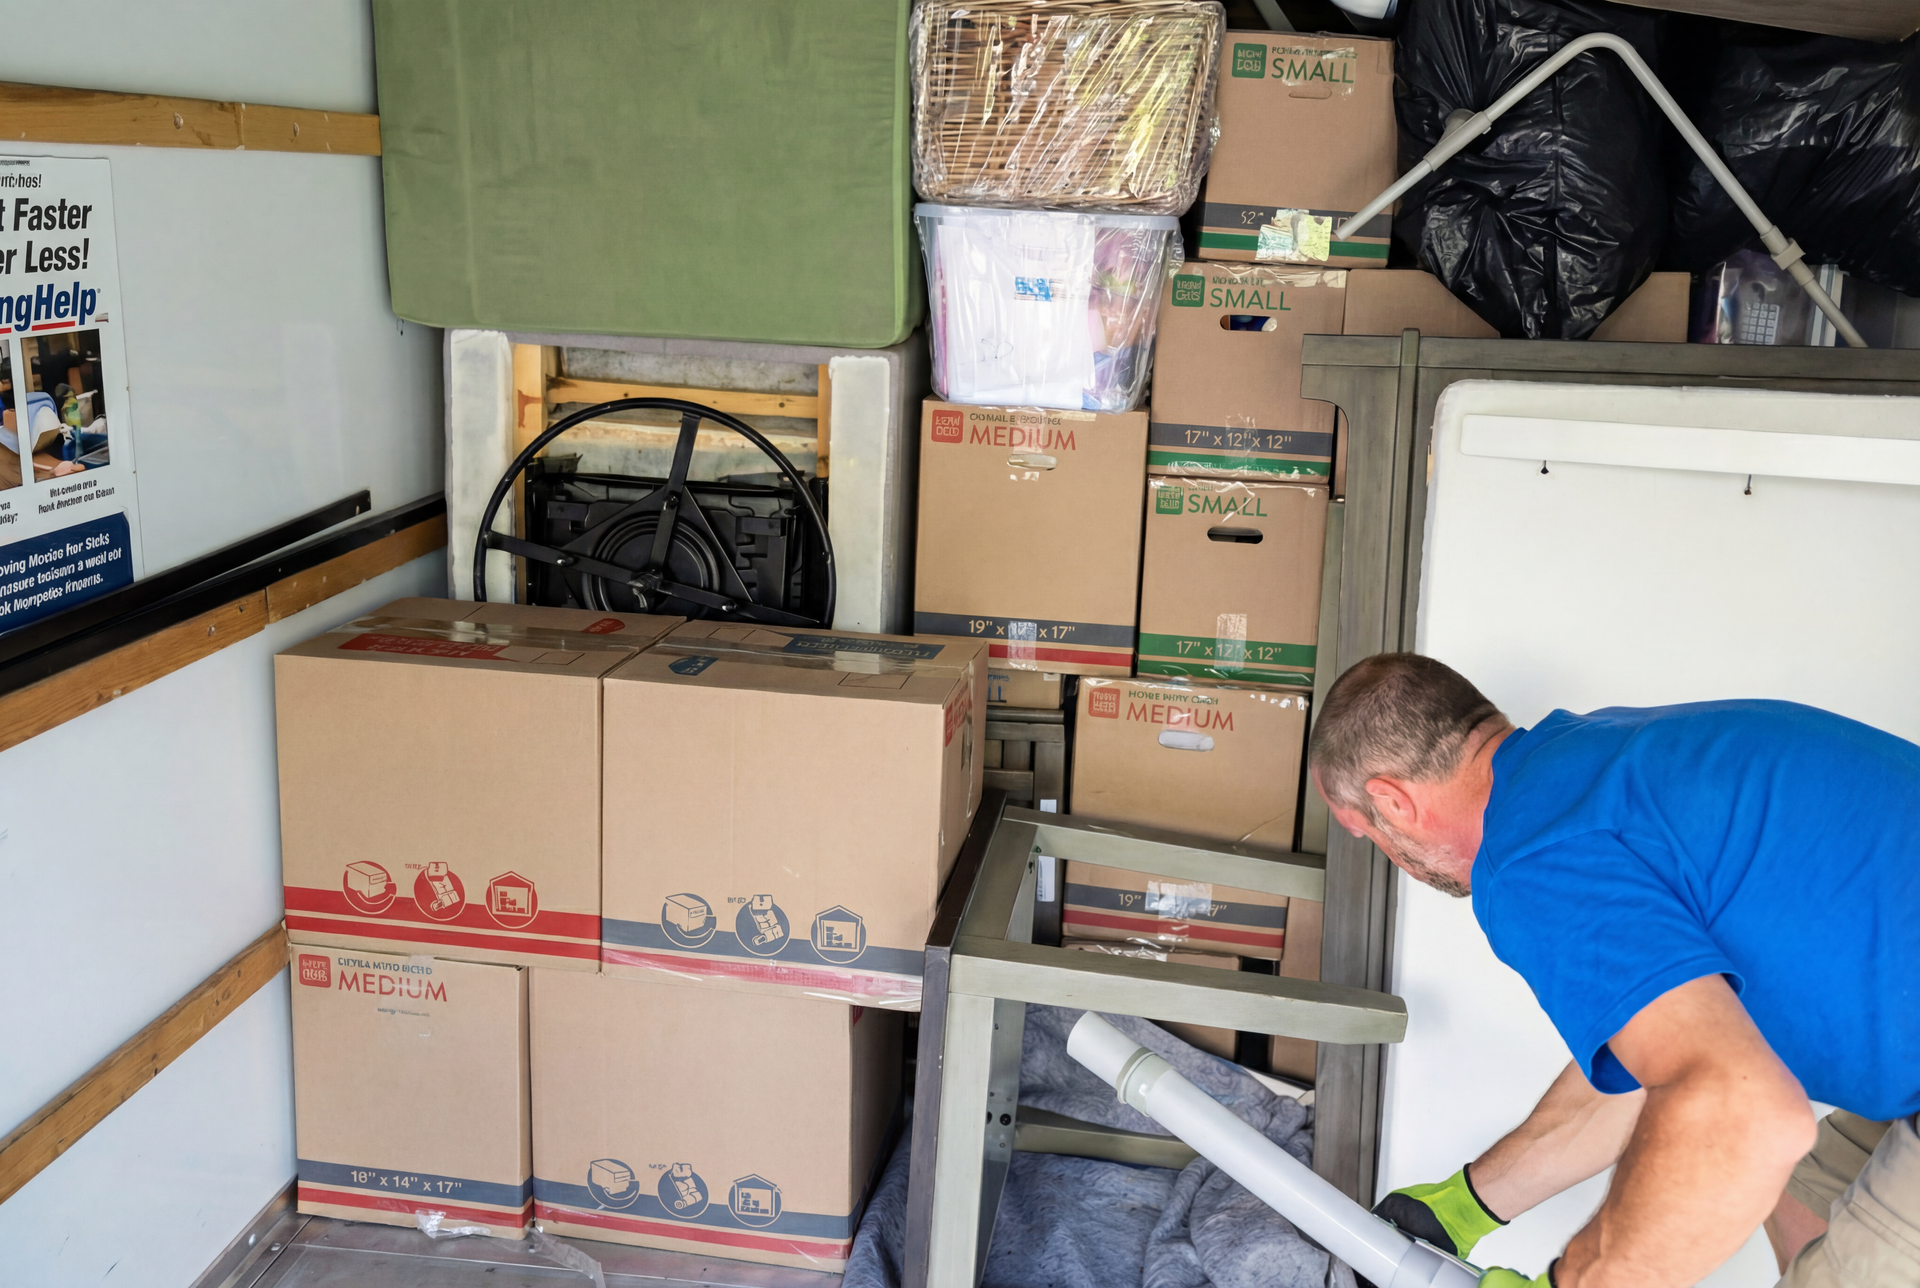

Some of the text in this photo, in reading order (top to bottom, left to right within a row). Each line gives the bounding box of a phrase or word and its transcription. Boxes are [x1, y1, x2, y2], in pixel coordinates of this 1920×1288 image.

[1271, 57, 1354, 83] SMALL
[13, 197, 92, 231] Faster
[25, 238, 89, 273] Less!
[1210, 287, 1291, 311] SMALL
[969, 424, 1076, 451] MEDIUM
[1184, 429, 1209, 444] 17"
[1213, 435, 1222, 446] x
[1252, 437, 1261, 448] x
[1266, 434, 1291, 449] 12"
[1187, 493, 1268, 517] SMALL
[968, 620, 993, 634] 19"
[996, 625, 1005, 635] x
[1039, 627, 1048, 638] x
[1052, 625, 1075, 639] 17"
[1176, 640, 1200, 654] 17"
[1204, 646, 1213, 656] x
[1244, 649, 1253, 660] x
[1257, 646, 1282, 660] 12"
[1126, 702, 1234, 731] MEDIUM
[1118, 893, 1142, 907] 19"
[338, 969, 448, 1002] MEDIUM
[380, 1176, 388, 1187] x
[393, 1175, 418, 1188] 14"
[423, 1181, 431, 1191] x
[436, 1180, 462, 1194] 17"
